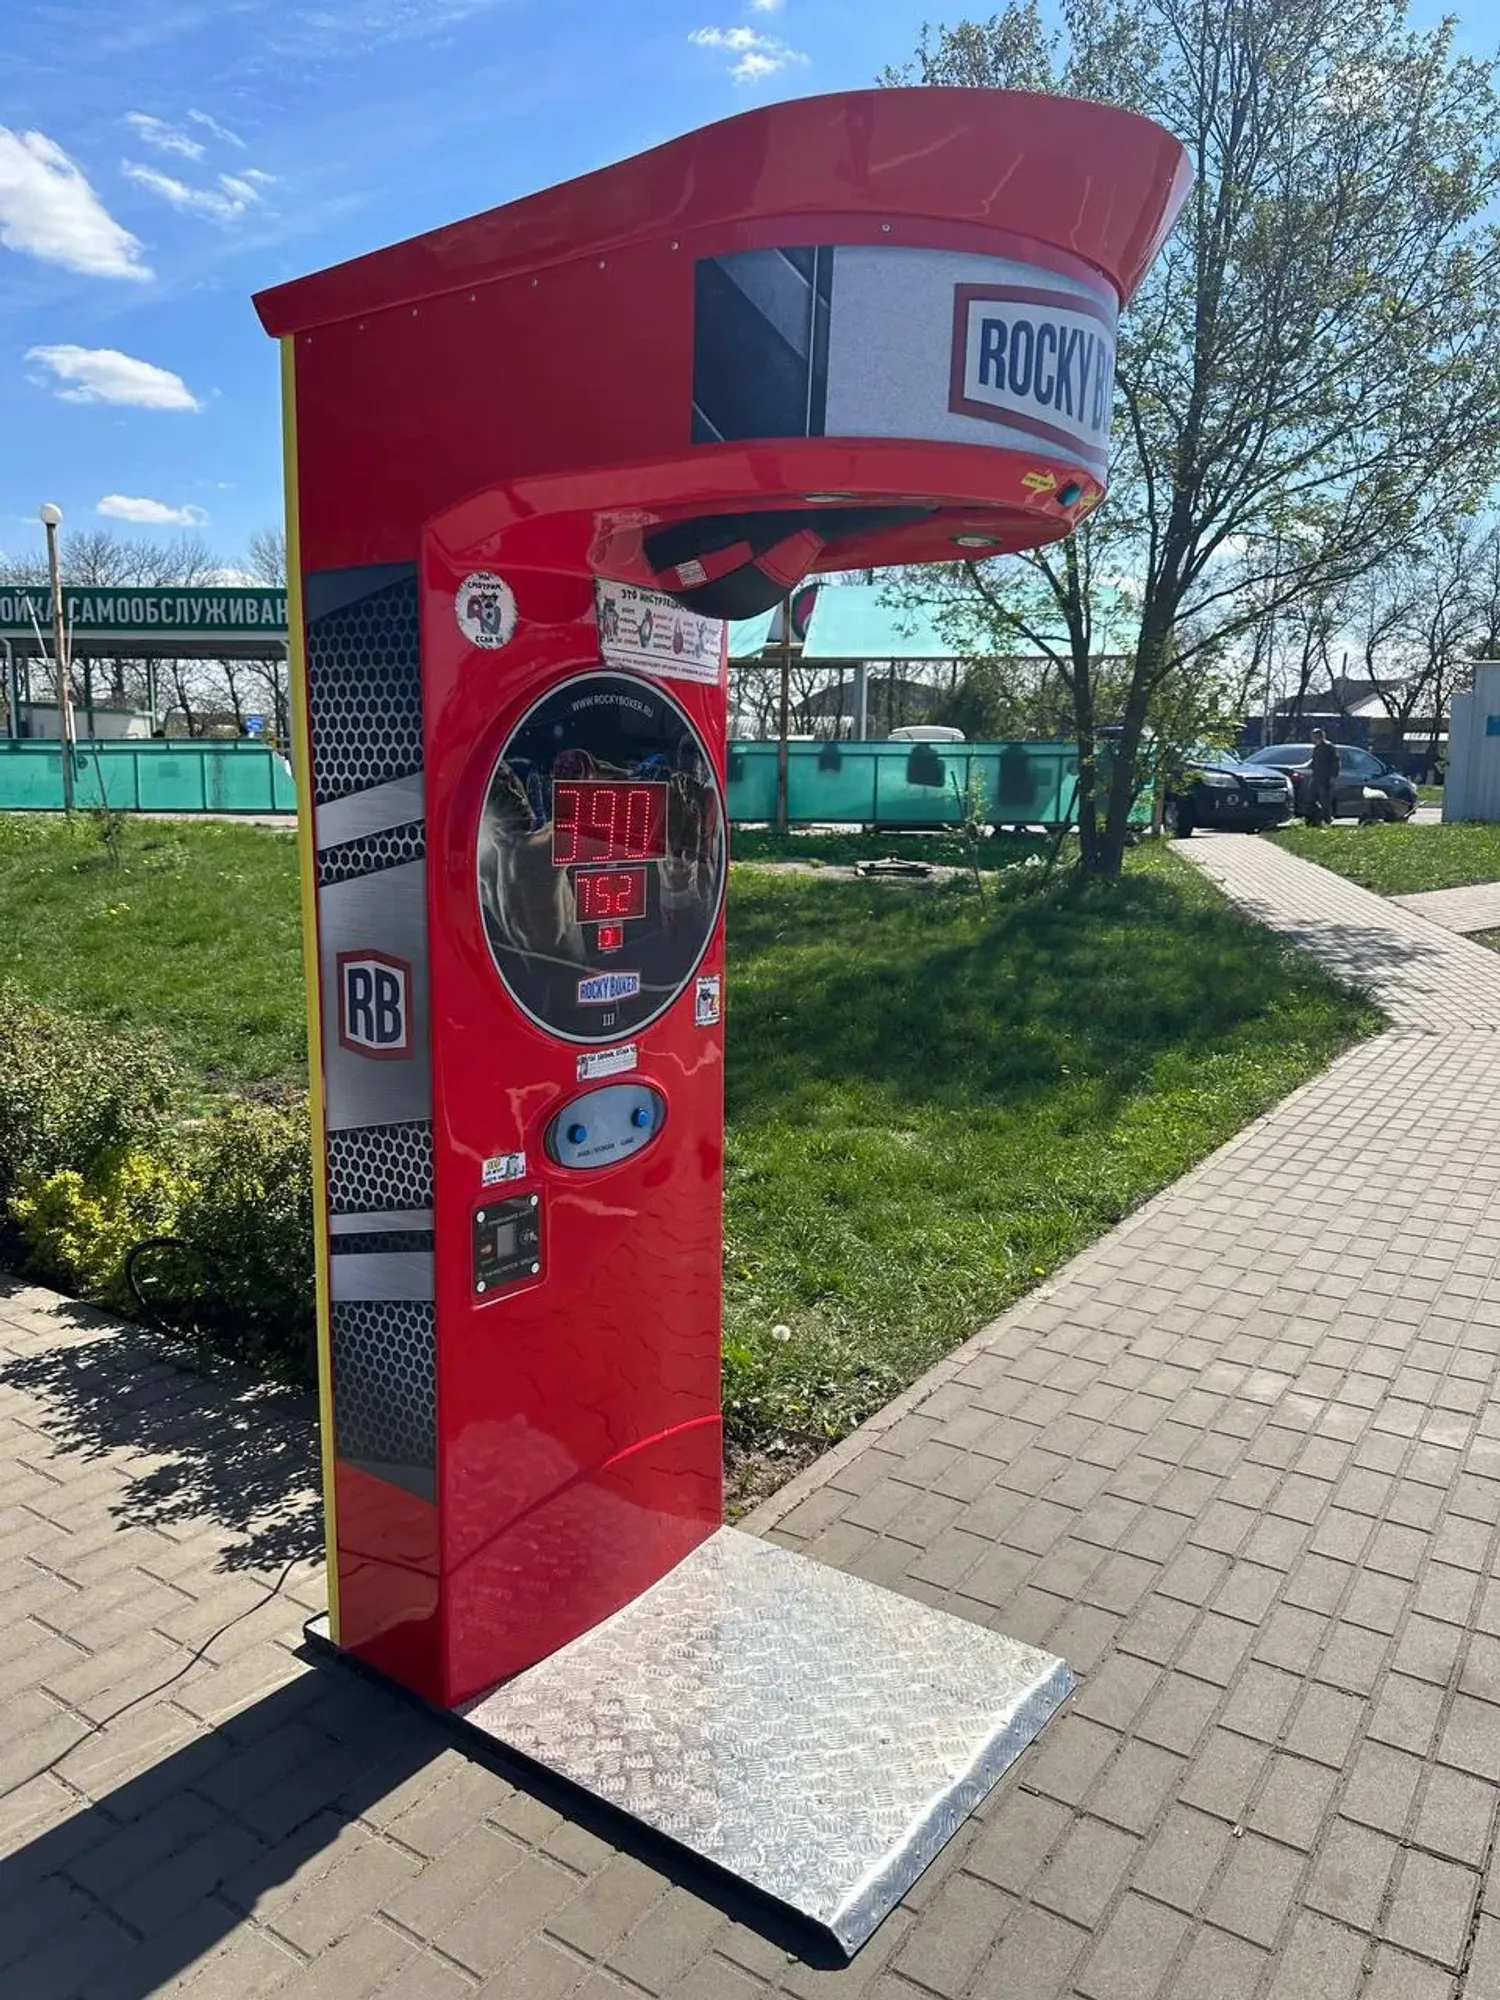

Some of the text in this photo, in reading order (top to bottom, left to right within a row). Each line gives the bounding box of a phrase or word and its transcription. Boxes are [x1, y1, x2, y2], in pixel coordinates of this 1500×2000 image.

[978, 317, 1095, 423] ROCKY
[0, 589, 289, 624] ОЙКА САМООБСЛУЖИВАН
[621, 589, 638, 600] ЭТО
[570, 693, 655, 719] WWW.ROCKYBOXER.RU
[555, 789, 651, 863] 390
[577, 874, 634, 914] 752
[347, 967, 403, 1043] RB
[580, 974, 637, 1000] ROCKY BOXER
